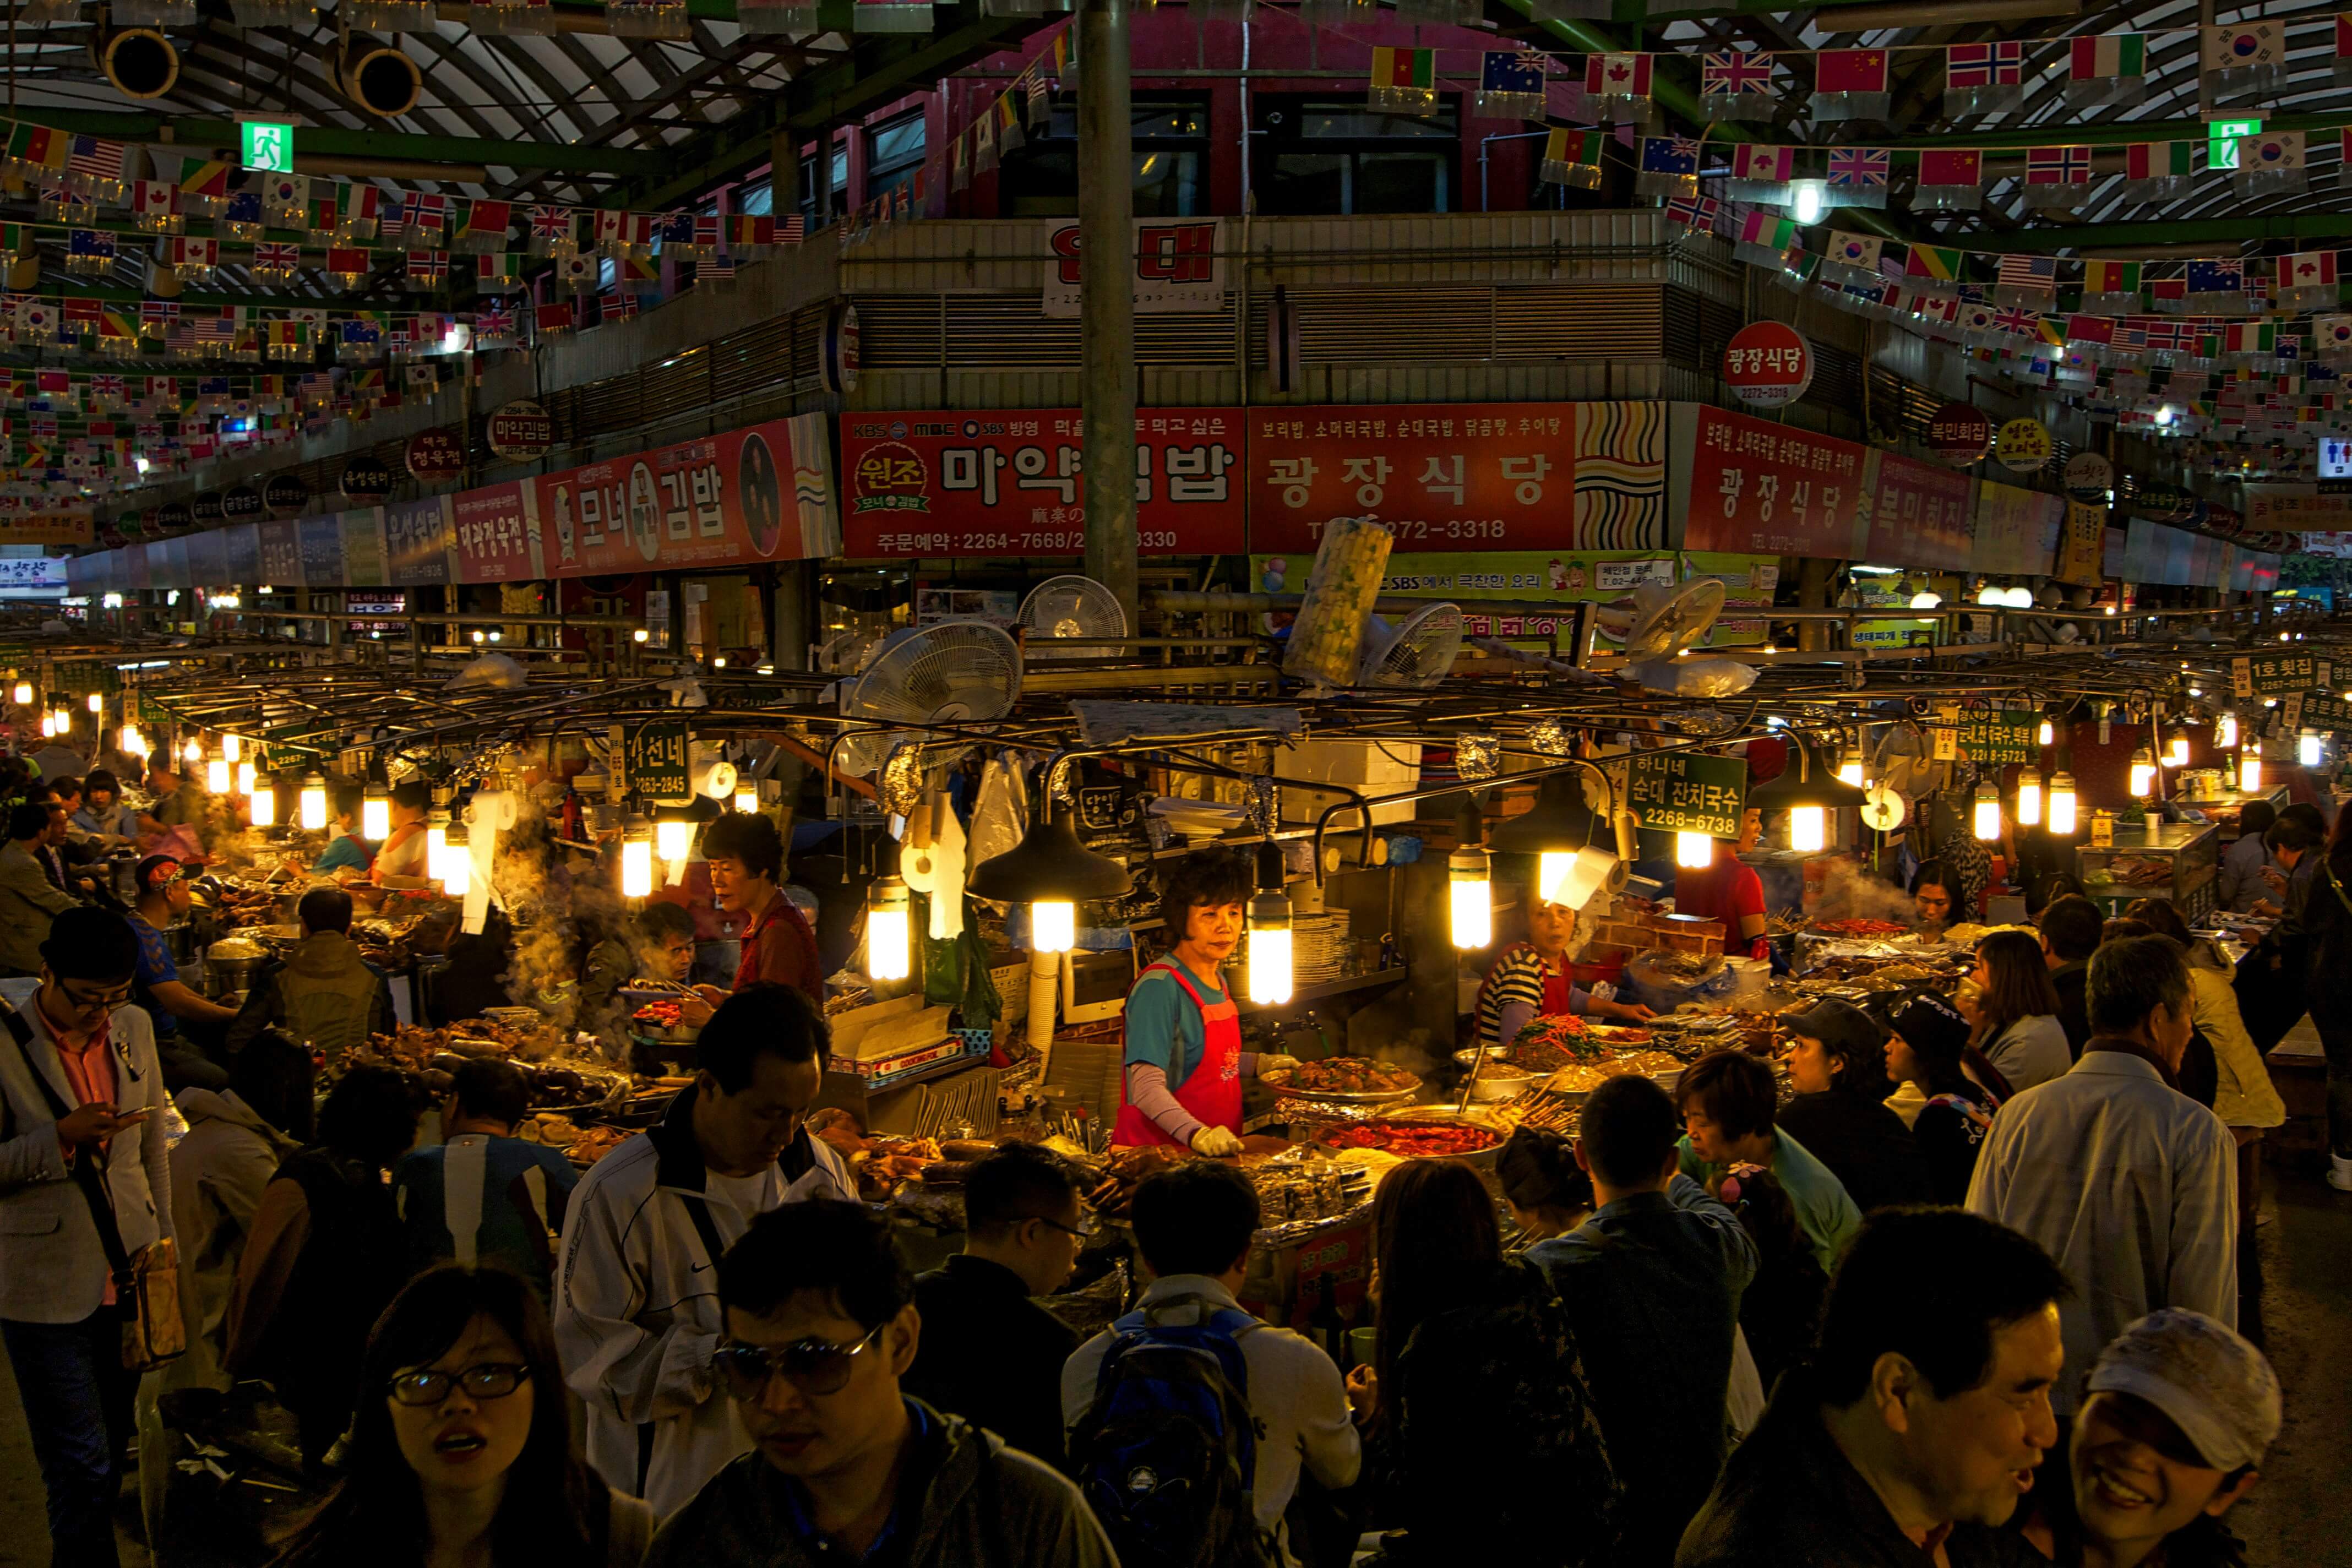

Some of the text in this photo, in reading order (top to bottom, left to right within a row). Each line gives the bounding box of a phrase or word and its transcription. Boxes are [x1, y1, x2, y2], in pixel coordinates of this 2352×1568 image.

[1728, 347, 1801, 374] 광장식당
[497, 421, 551, 440] 마약김밥
[853, 423, 887, 438] KBS
[982, 422, 1005, 435] SBS
[1009, 421, 1039, 437] 방영
[1152, 418, 1186, 435] 먹고
[1191, 417, 1227, 435] 싶은
[413, 450, 461, 467] 정육점
[2000, 439, 2046, 455] 보리밥
[861, 458, 924, 489] 원조
[1267, 454, 1553, 508] 광장식당
[580, 480, 630, 547] 모녀
[661, 464, 724, 540] 김밥
[1719, 469, 1841, 529] 광장식당
[460, 515, 525, 559] 대광정육점
[1458, 574, 1506, 589] 극찬한
[1510, 574, 1541, 589] 요리
[2252, 658, 2312, 678] 1호 횟집
[1637, 755, 1686, 777] 하니네
[1633, 775, 1740, 814] 순대 잔치국수
[1646, 807, 1735, 835] 2268-6738
